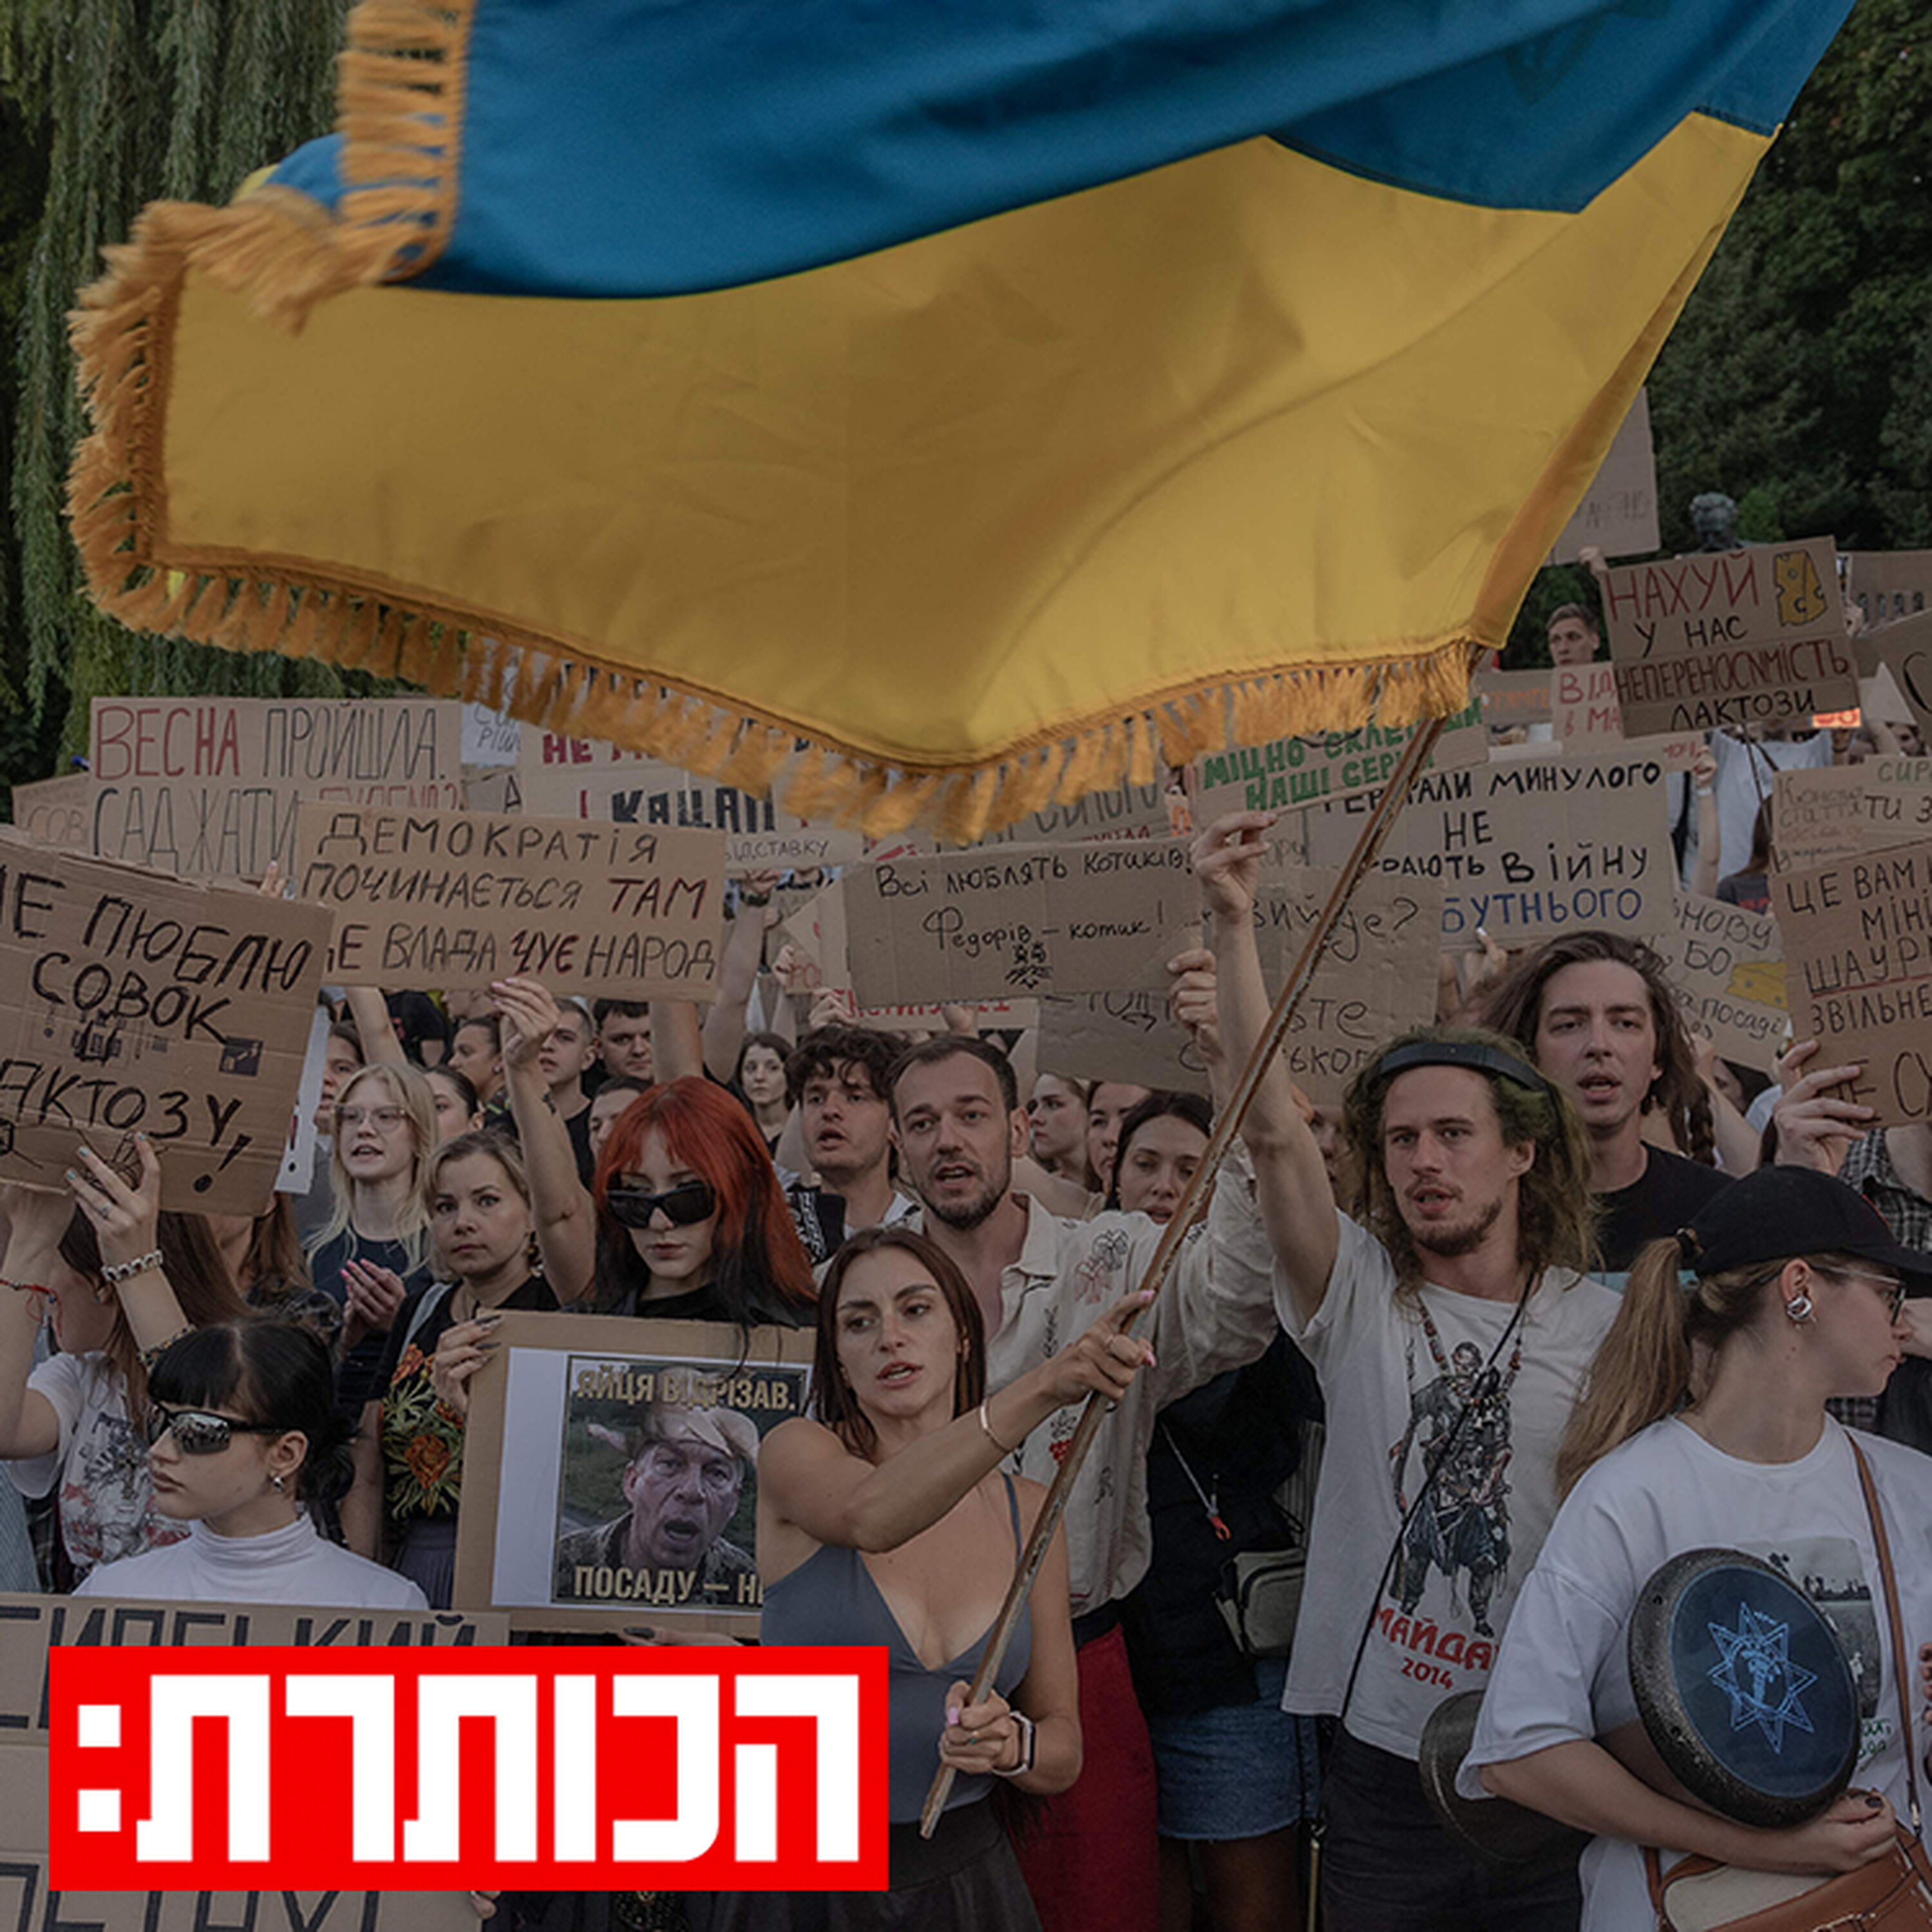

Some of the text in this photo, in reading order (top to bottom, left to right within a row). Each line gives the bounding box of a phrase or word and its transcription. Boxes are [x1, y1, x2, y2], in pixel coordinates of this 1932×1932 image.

[1605, 553, 1759, 621] НАХУЙ
[1634, 615, 1748, 658] У НАС
[1671, 689, 1815, 732] ЛАКТОЗИ
[95, 702, 446, 780] ВЕСНА ПРОЙШЛА.
[543, 734, 593, 764] НЕ
[1204, 737, 1305, 790] МІЦНО
[1245, 766, 1331, 811] НАШІ
[1488, 761, 1661, 797] МИНУЛОГО
[93, 787, 299, 873] САДЖАТИ
[316, 813, 658, 866] ДЕМОКРАТІЯ
[1444, 810, 1493, 852] НЕ
[876, 864, 928, 897] Всі
[1501, 842, 1647, 883] ВІЙНУ
[1786, 858, 1915, 915] ЦЕ ВАМ
[301, 862, 707, 920] ПОЧИНАЄТЬСЯ ТАМ
[1441, 887, 1642, 933] БУТНЬОГО
[1861, 889, 1932, 942] МІНІ
[0, 864, 314, 993] Е ЛЮБЛЮ
[327, 923, 370, 973] Е
[382, 922, 497, 973] ВЛАДА
[582, 931, 716, 981] НАРОД
[1804, 935, 1932, 994] ШАУР
[31, 951, 234, 1045] СОВОК
[576, 1363, 797, 1411] ЯЙЦЯ ВІДРІЗАВ.
[574, 1565, 696, 1605] ПОСАДУ
[737, 1573, 762, 1604] Н
[1372, 1604, 1499, 1672] МАЙДА
[1400, 1655, 1453, 1689] 2014
